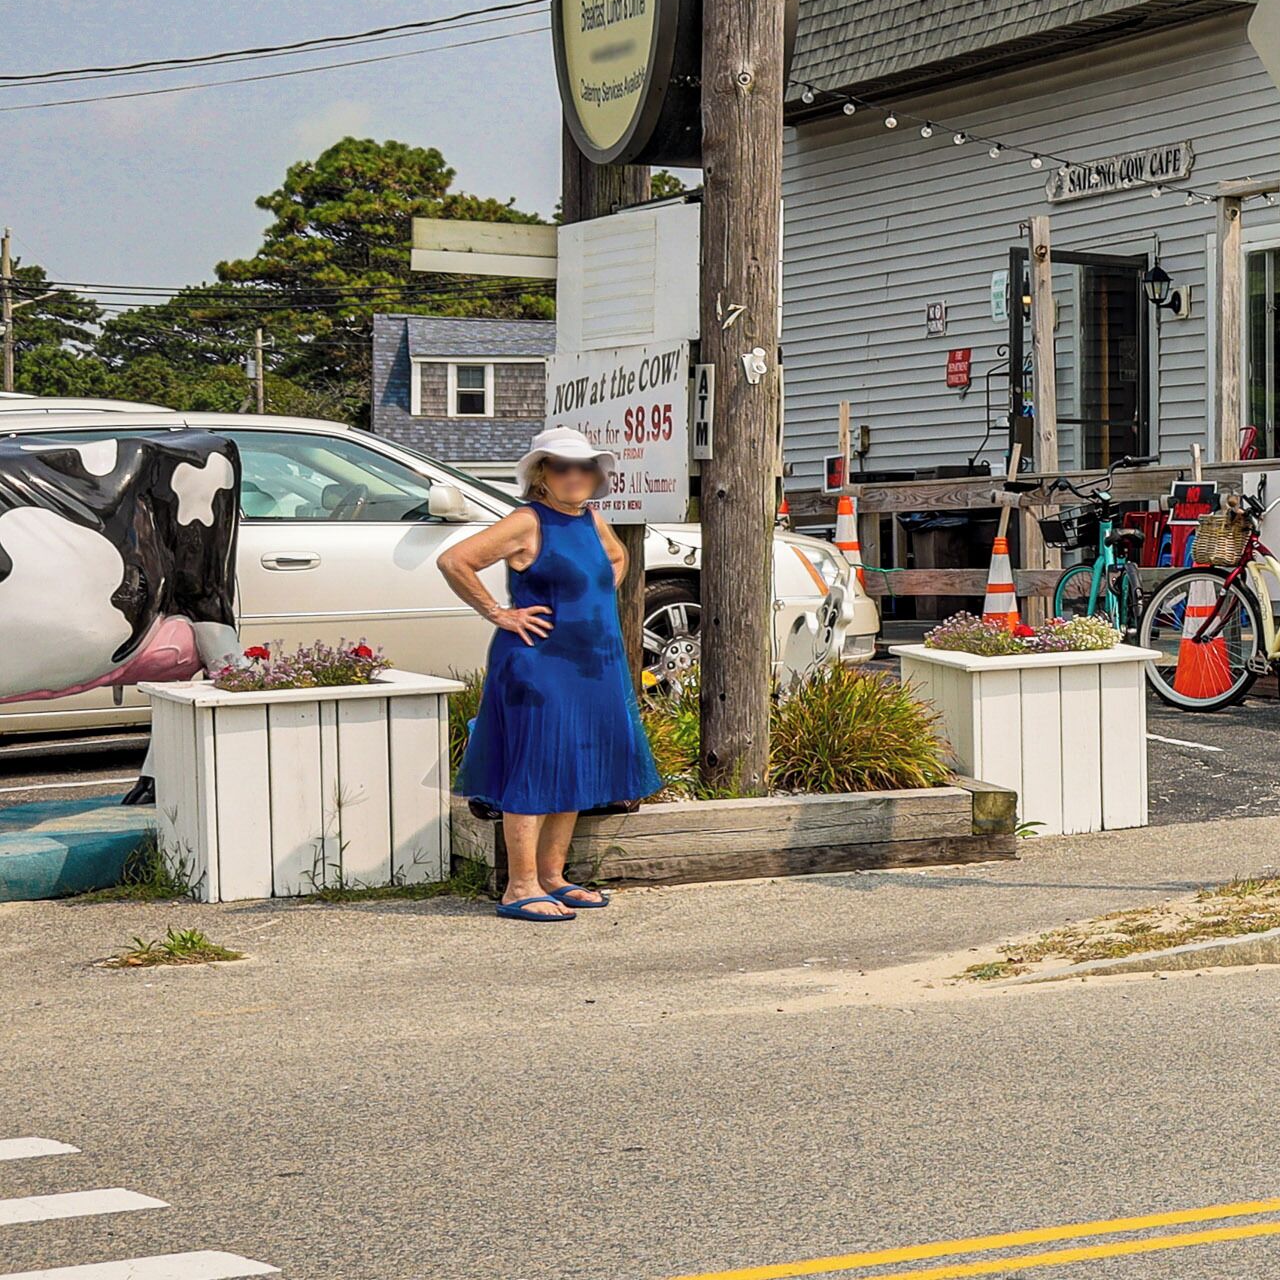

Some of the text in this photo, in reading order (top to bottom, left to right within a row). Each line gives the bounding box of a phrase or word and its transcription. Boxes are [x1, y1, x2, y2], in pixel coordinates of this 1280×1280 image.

[580, 78, 601, 107] Catering
[602, 80, 624, 101] Services
[1119, 156, 1147, 182] COW
[1149, 148, 1180, 177] CAFE
[553, 348, 681, 416] NOW at the COW!
[695, 369, 709, 446] ATM
[605, 419, 620, 444] for
[624, 404, 673, 444] $8.95
[623, 447, 645, 460] FRIDAY
[629, 471, 642, 494] All
[644, 471, 676, 493] Summer
[627, 500, 642, 511] MENU
